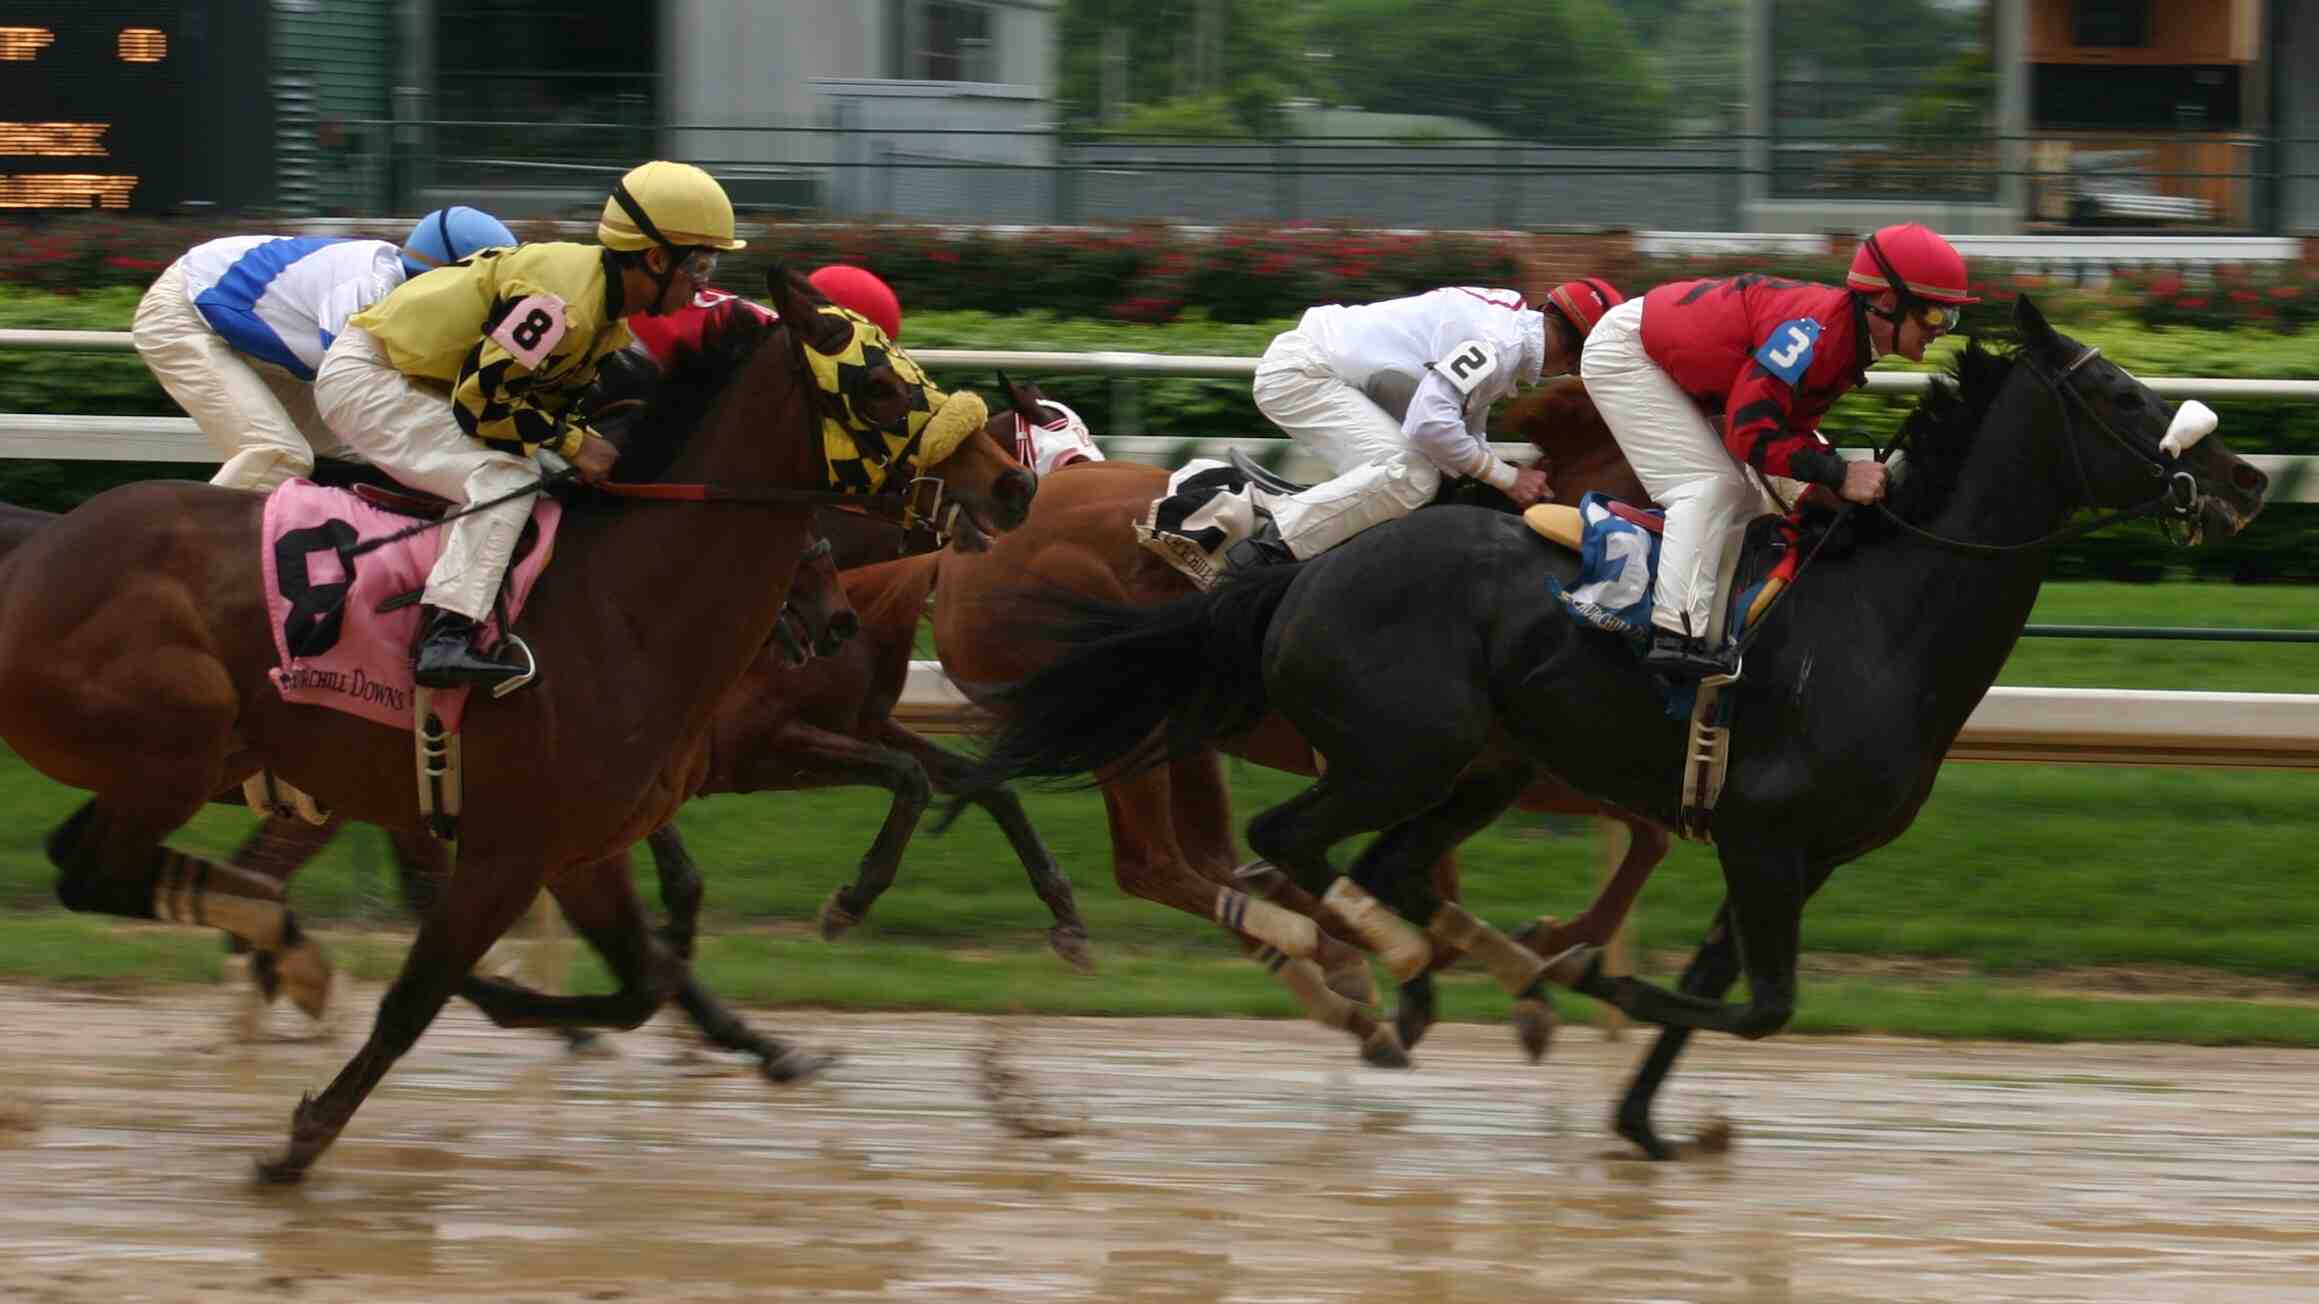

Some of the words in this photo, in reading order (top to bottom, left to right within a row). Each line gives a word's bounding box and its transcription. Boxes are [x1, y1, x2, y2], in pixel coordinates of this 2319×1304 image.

[512, 308, 553, 350] 8
[1769, 326, 1810, 369] 3
[1450, 345, 1488, 380] 2
[275, 518, 360, 658] 8
[282, 669, 347, 693] HURCHILL
[350, 668, 404, 711] DOWNS
